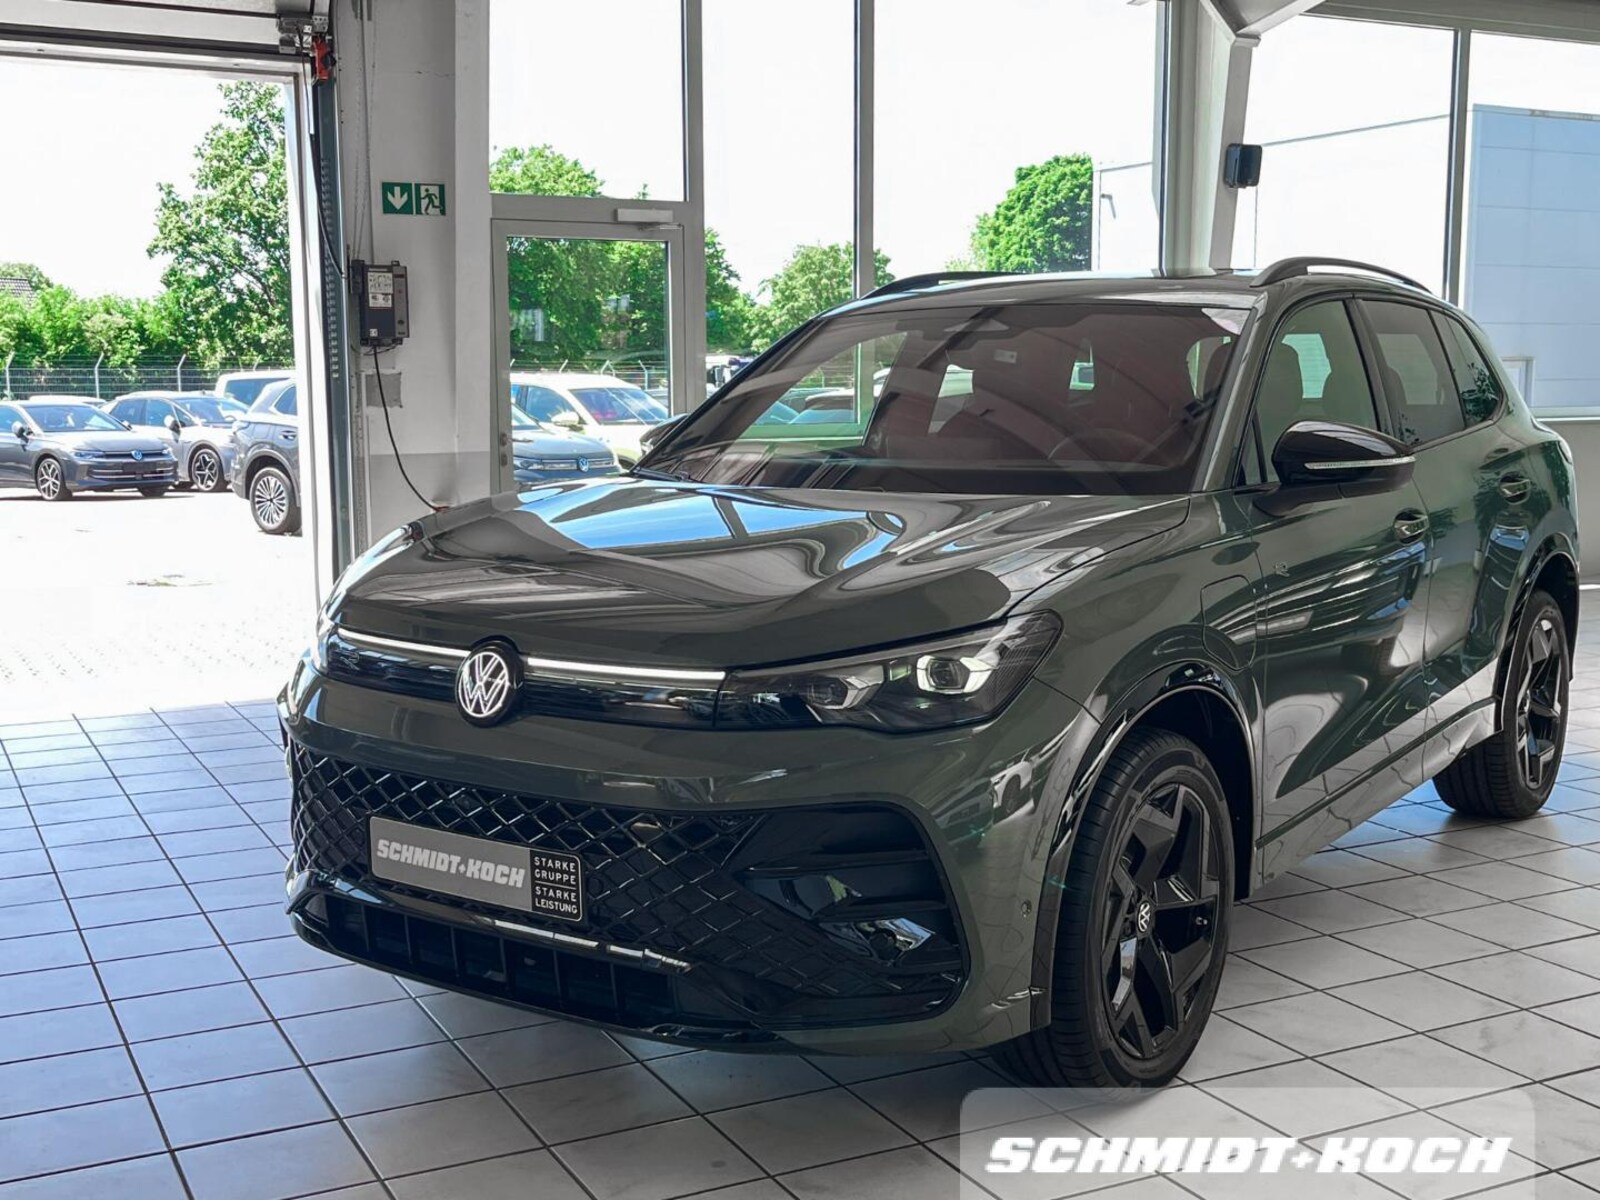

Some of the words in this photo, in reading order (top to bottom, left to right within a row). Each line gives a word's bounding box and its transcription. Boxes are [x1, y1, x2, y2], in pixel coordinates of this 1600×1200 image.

[377, 839, 525, 888] SCHMIDT+KOCH
[534, 857, 576, 872] STARKE
[534, 869, 576, 885] GRUPPE
[535, 886, 577, 902] STARKE
[535, 898, 577, 914] LEISTUNG
